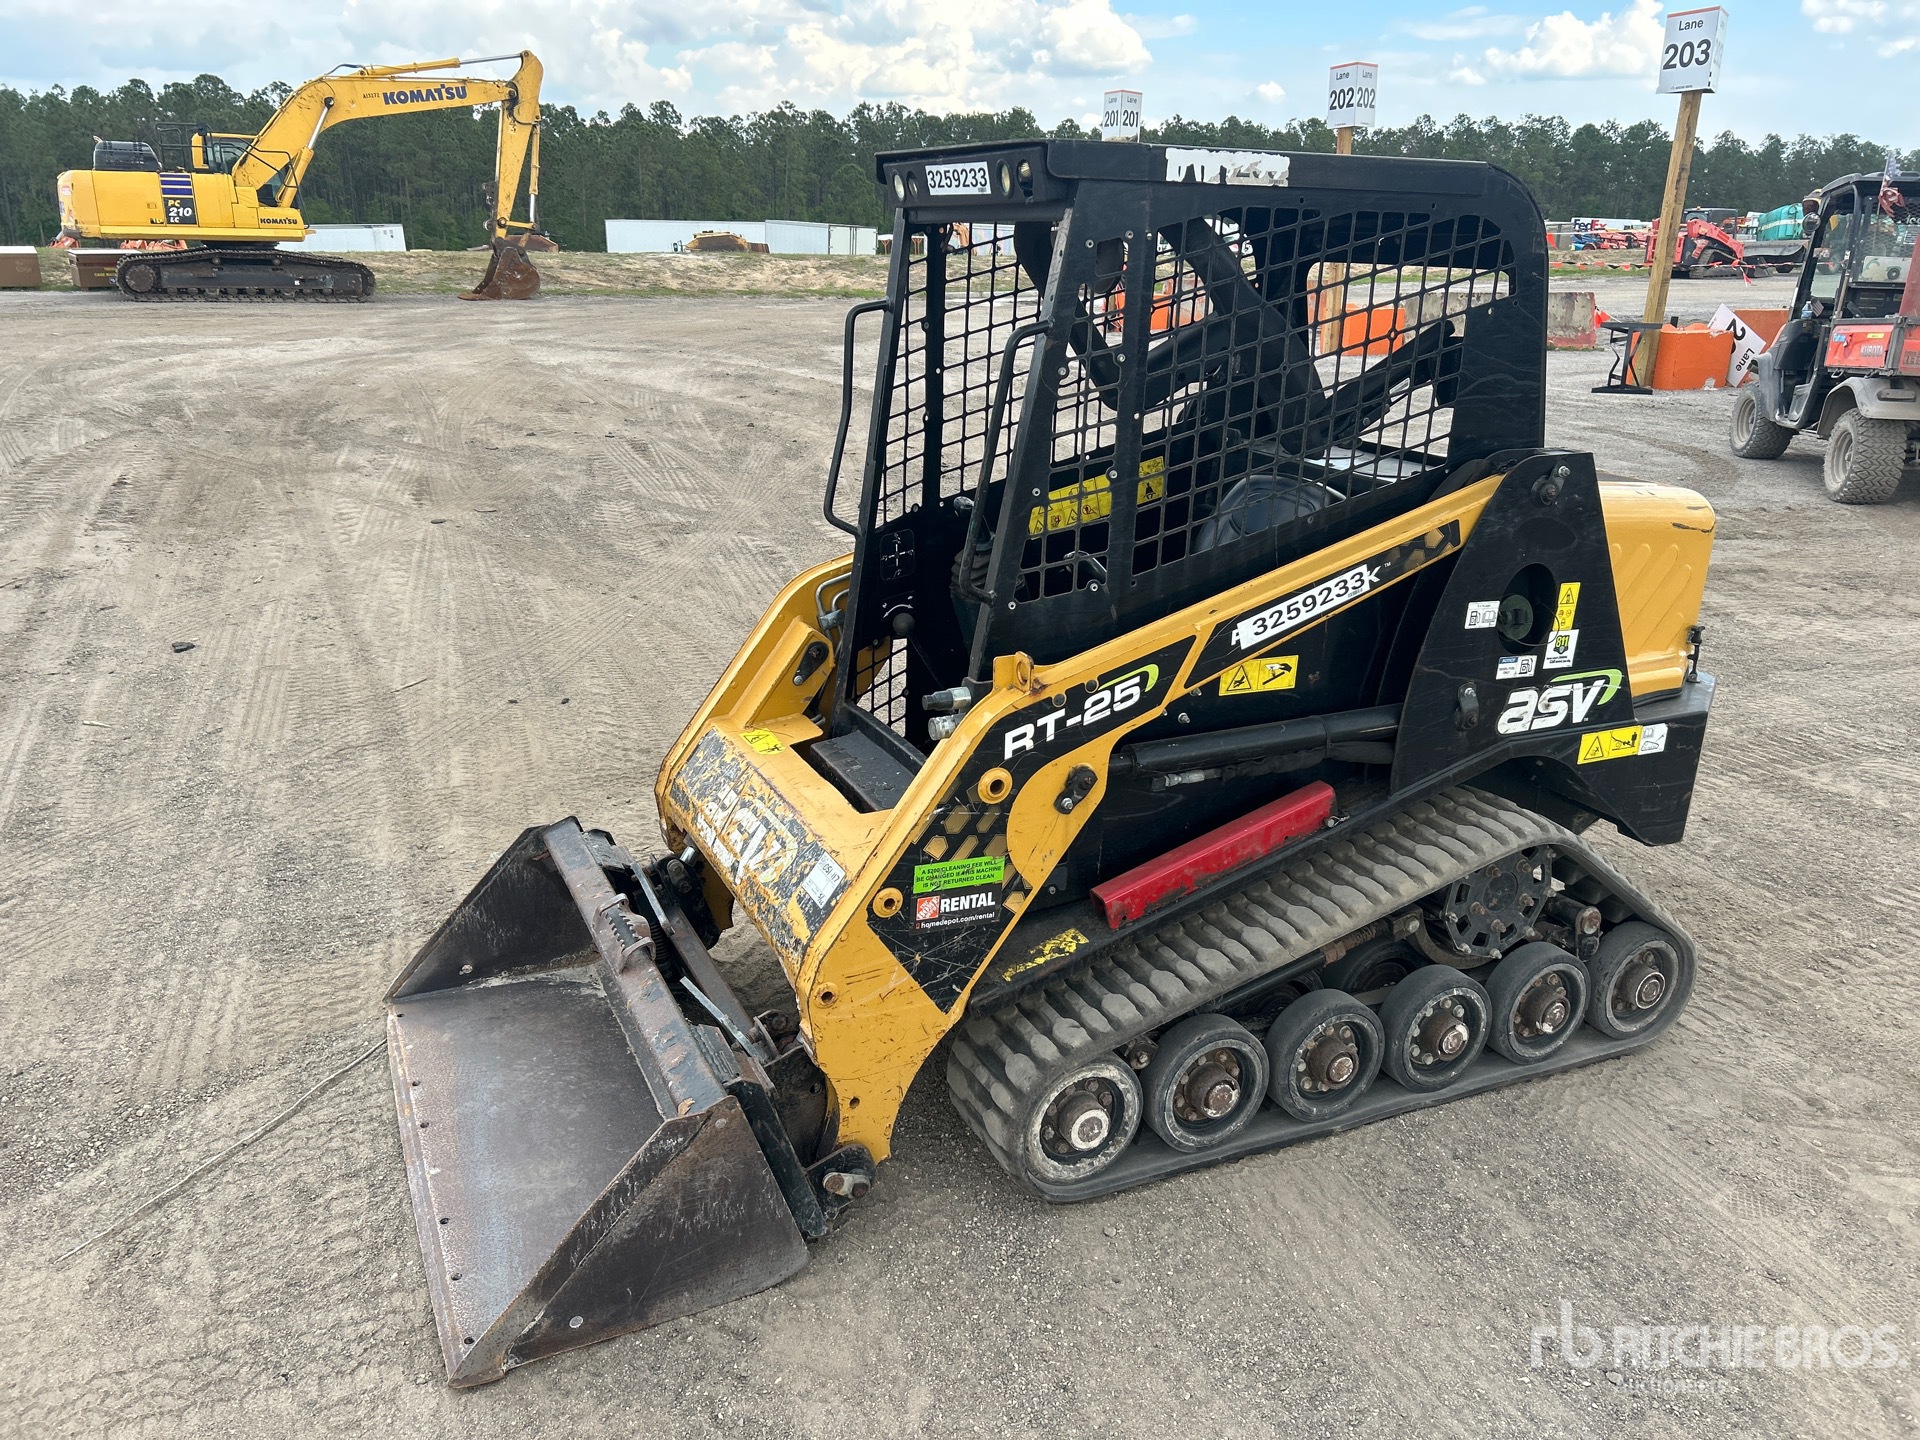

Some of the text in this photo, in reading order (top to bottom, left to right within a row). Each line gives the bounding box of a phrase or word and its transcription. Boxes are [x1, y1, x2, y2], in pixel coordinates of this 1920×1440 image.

[1678, 19, 1704, 31] Lane
[1662, 38, 1712, 70] 203
[1336, 71, 1350, 80] Lane
[1362, 70, 1373, 79] Lane
[382, 84, 468, 105] KOMATSU
[1329, 86, 1355, 111] 202
[1356, 86, 1376, 109] 202
[1104, 109, 1119, 128] 201
[1122, 109, 1139, 128] 201
[927, 167, 988, 189] 3259233
[168, 207, 193, 217] 210
[260, 217, 297, 225] KOMATSU
[1735, 347, 1755, 372] Lane
[1252, 571, 1365, 636] 3259233
[1555, 634, 1571, 648] 811
[1004, 675, 1141, 760] RT-25
[941, 863, 971, 873] CLEANING
[971, 861, 983, 869] FEE
[976, 865, 1002, 874] MACHINE
[929, 880, 942, 888] NOT
[943, 876, 975, 886] RETURNED
[975, 873, 995, 881] CLEAN
[940, 891, 996, 913] RENTAL
[920, 912, 995, 928] homedepot.com/rental
